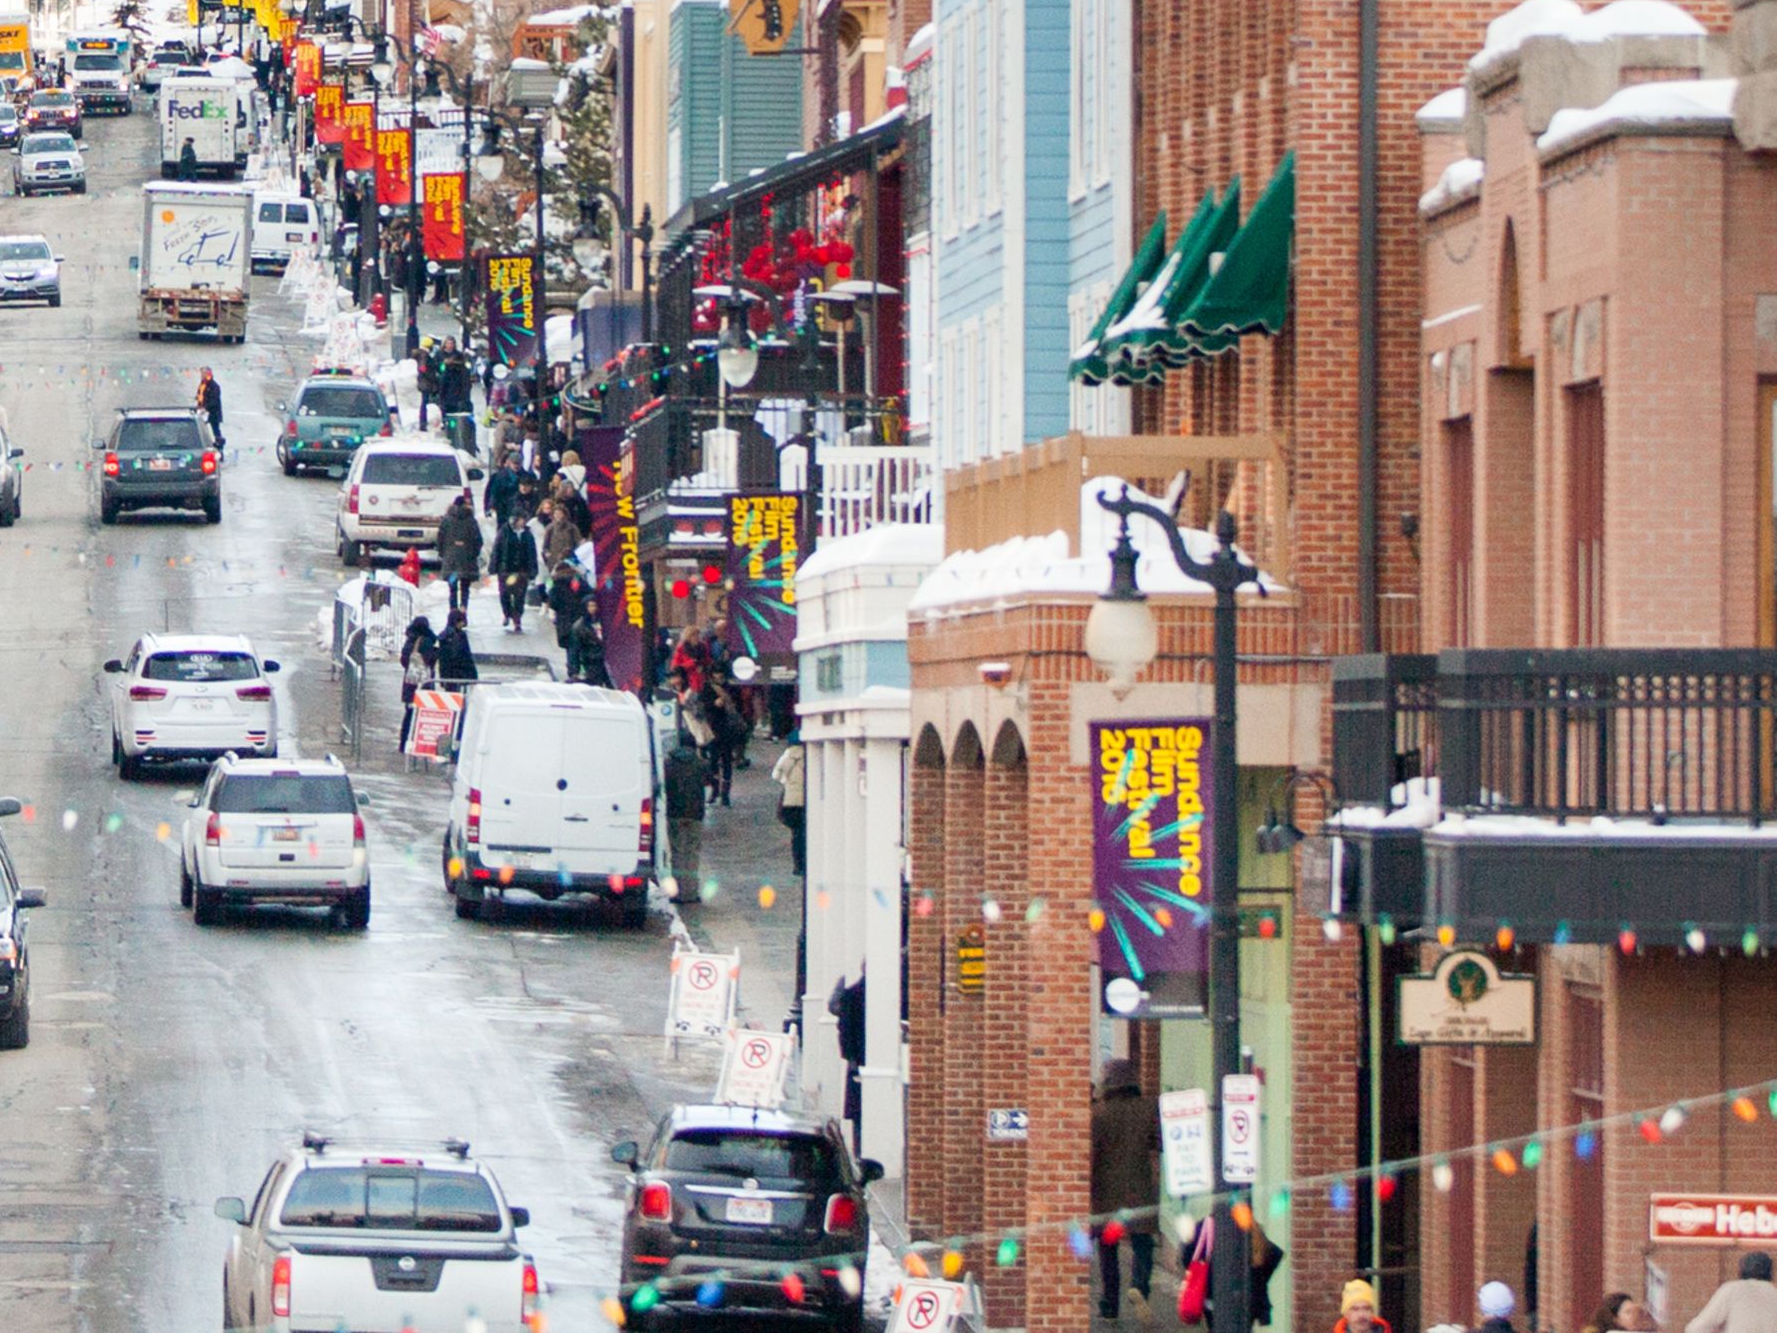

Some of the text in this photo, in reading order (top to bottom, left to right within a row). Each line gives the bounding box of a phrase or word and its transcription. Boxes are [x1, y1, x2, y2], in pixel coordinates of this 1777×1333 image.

[168, 100, 228, 120] FedEx
[522, 257, 534, 329] Sundance
[732, 497, 748, 546] 2016
[748, 497, 765, 579] Festival
[764, 497, 780, 540] Film
[781, 496, 798, 604] Sundance
[620, 527, 644, 629] Frontier
[1100, 729, 1126, 805] 2016
[1125, 728, 1155, 858] Festival
[1151, 727, 1175, 797] Film
[1175, 726, 1202, 896] Sundance
